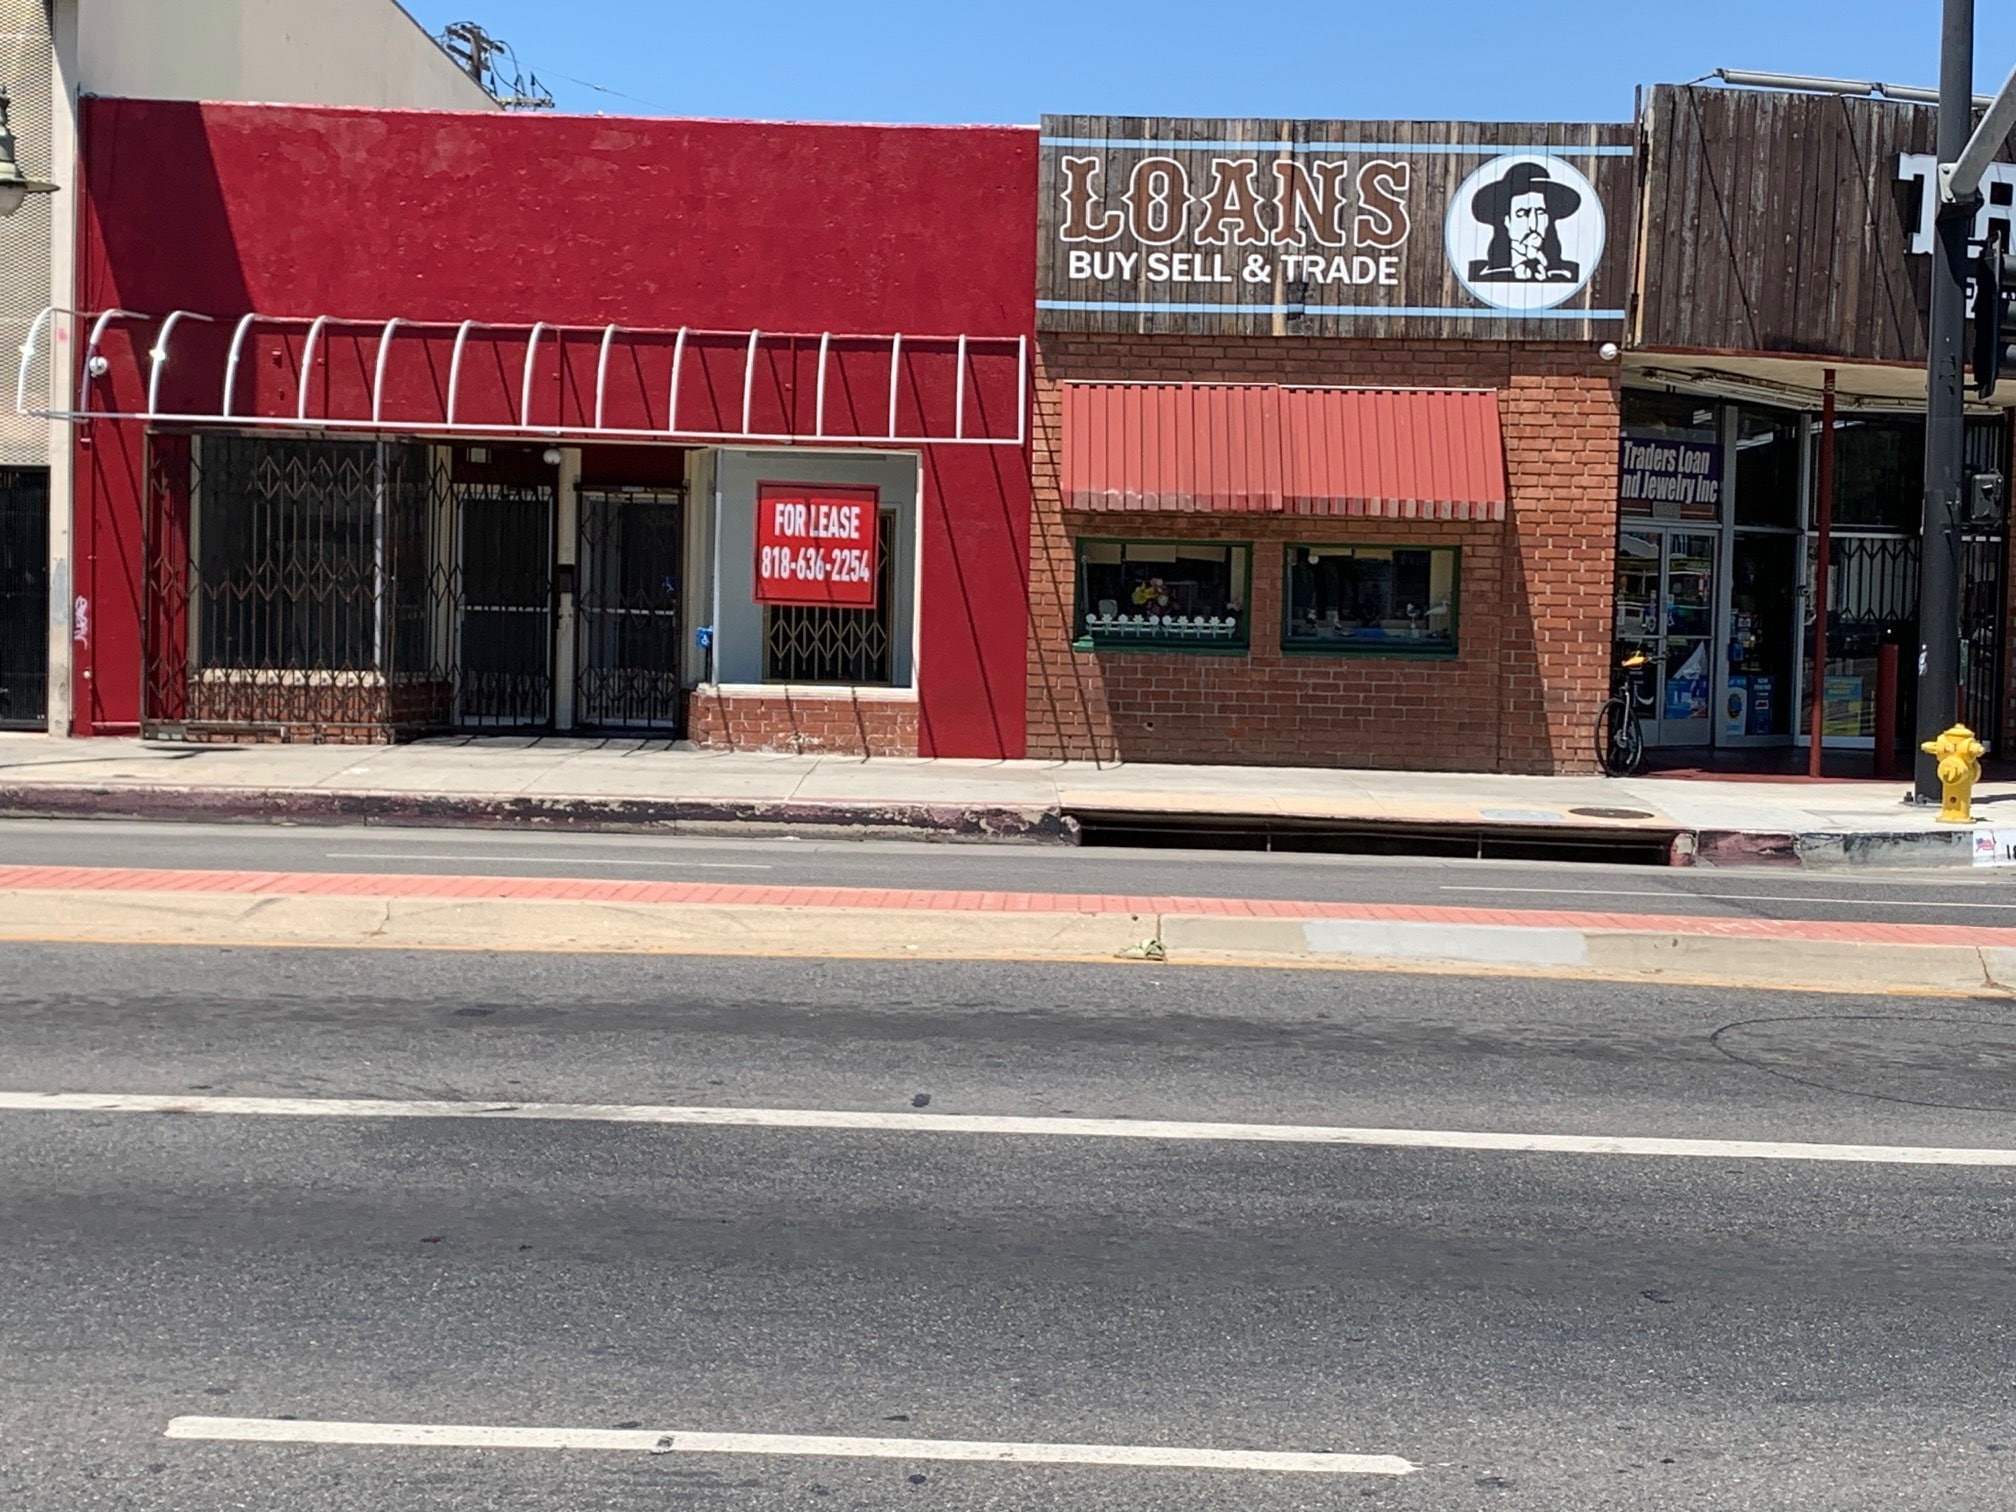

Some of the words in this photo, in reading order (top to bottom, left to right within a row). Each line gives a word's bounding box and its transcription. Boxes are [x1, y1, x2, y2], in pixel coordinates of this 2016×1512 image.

[1060, 155, 1411, 249] LOANS
[1069, 251, 1138, 281] BUY
[1147, 252, 1233, 283] SELL
[1242, 256, 1272, 285] &
[1282, 254, 1399, 285] TRADE
[1623, 441, 1677, 472] Traders
[1678, 445, 1710, 474] Loan
[1641, 472, 1696, 504] Jewelry
[1696, 475, 1718, 503] Inc
[774, 503, 806, 537] FOR
[809, 504, 861, 539] LEASE
[762, 545, 870, 582] 818-636-2254
